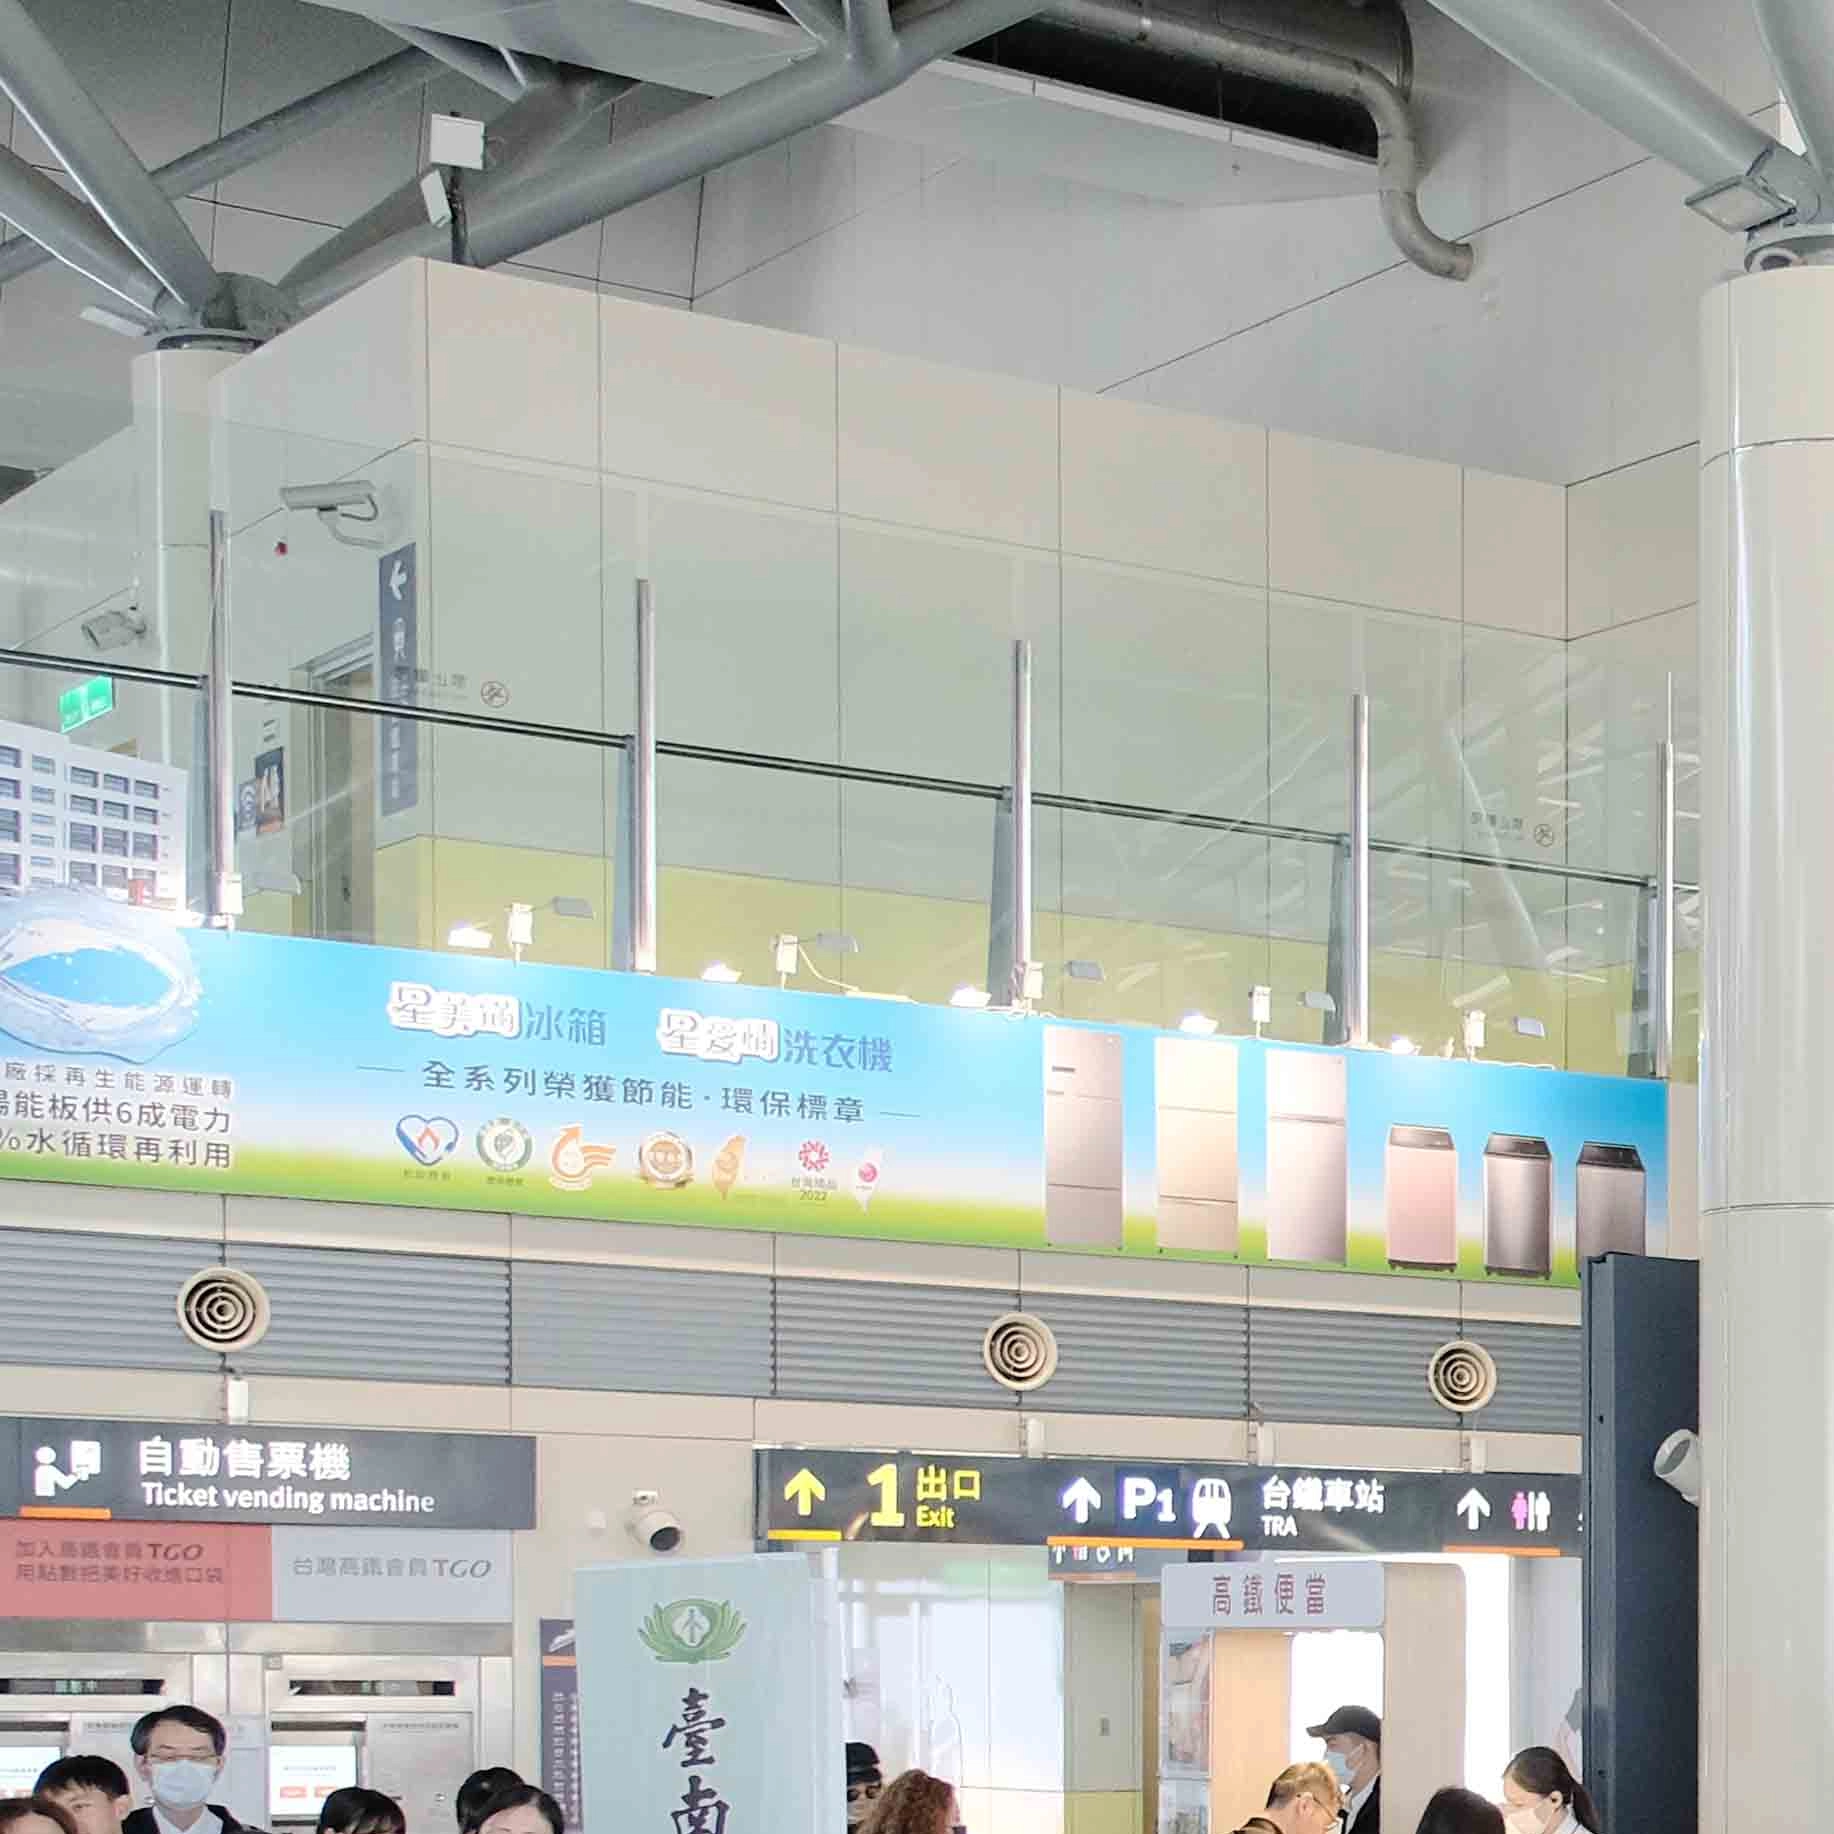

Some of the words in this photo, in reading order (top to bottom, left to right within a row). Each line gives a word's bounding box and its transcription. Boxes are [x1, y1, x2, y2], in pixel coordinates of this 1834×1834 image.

[138, 1435, 352, 1481] 自動售票機
[142, 1482, 219, 1508] Ticket
[223, 1486, 325, 1515] vending
[330, 1488, 435, 1513] machine
[866, 1463, 906, 1528] 1
[916, 1465, 982, 1502] 出口
[916, 1505, 955, 1529] Exit
[1121, 1477, 1177, 1522] P1
[1262, 1474, 1385, 1514] 台鐵車站
[1261, 1514, 1298, 1537] TRA
[1211, 1572, 1328, 1617] 高鐵便當
